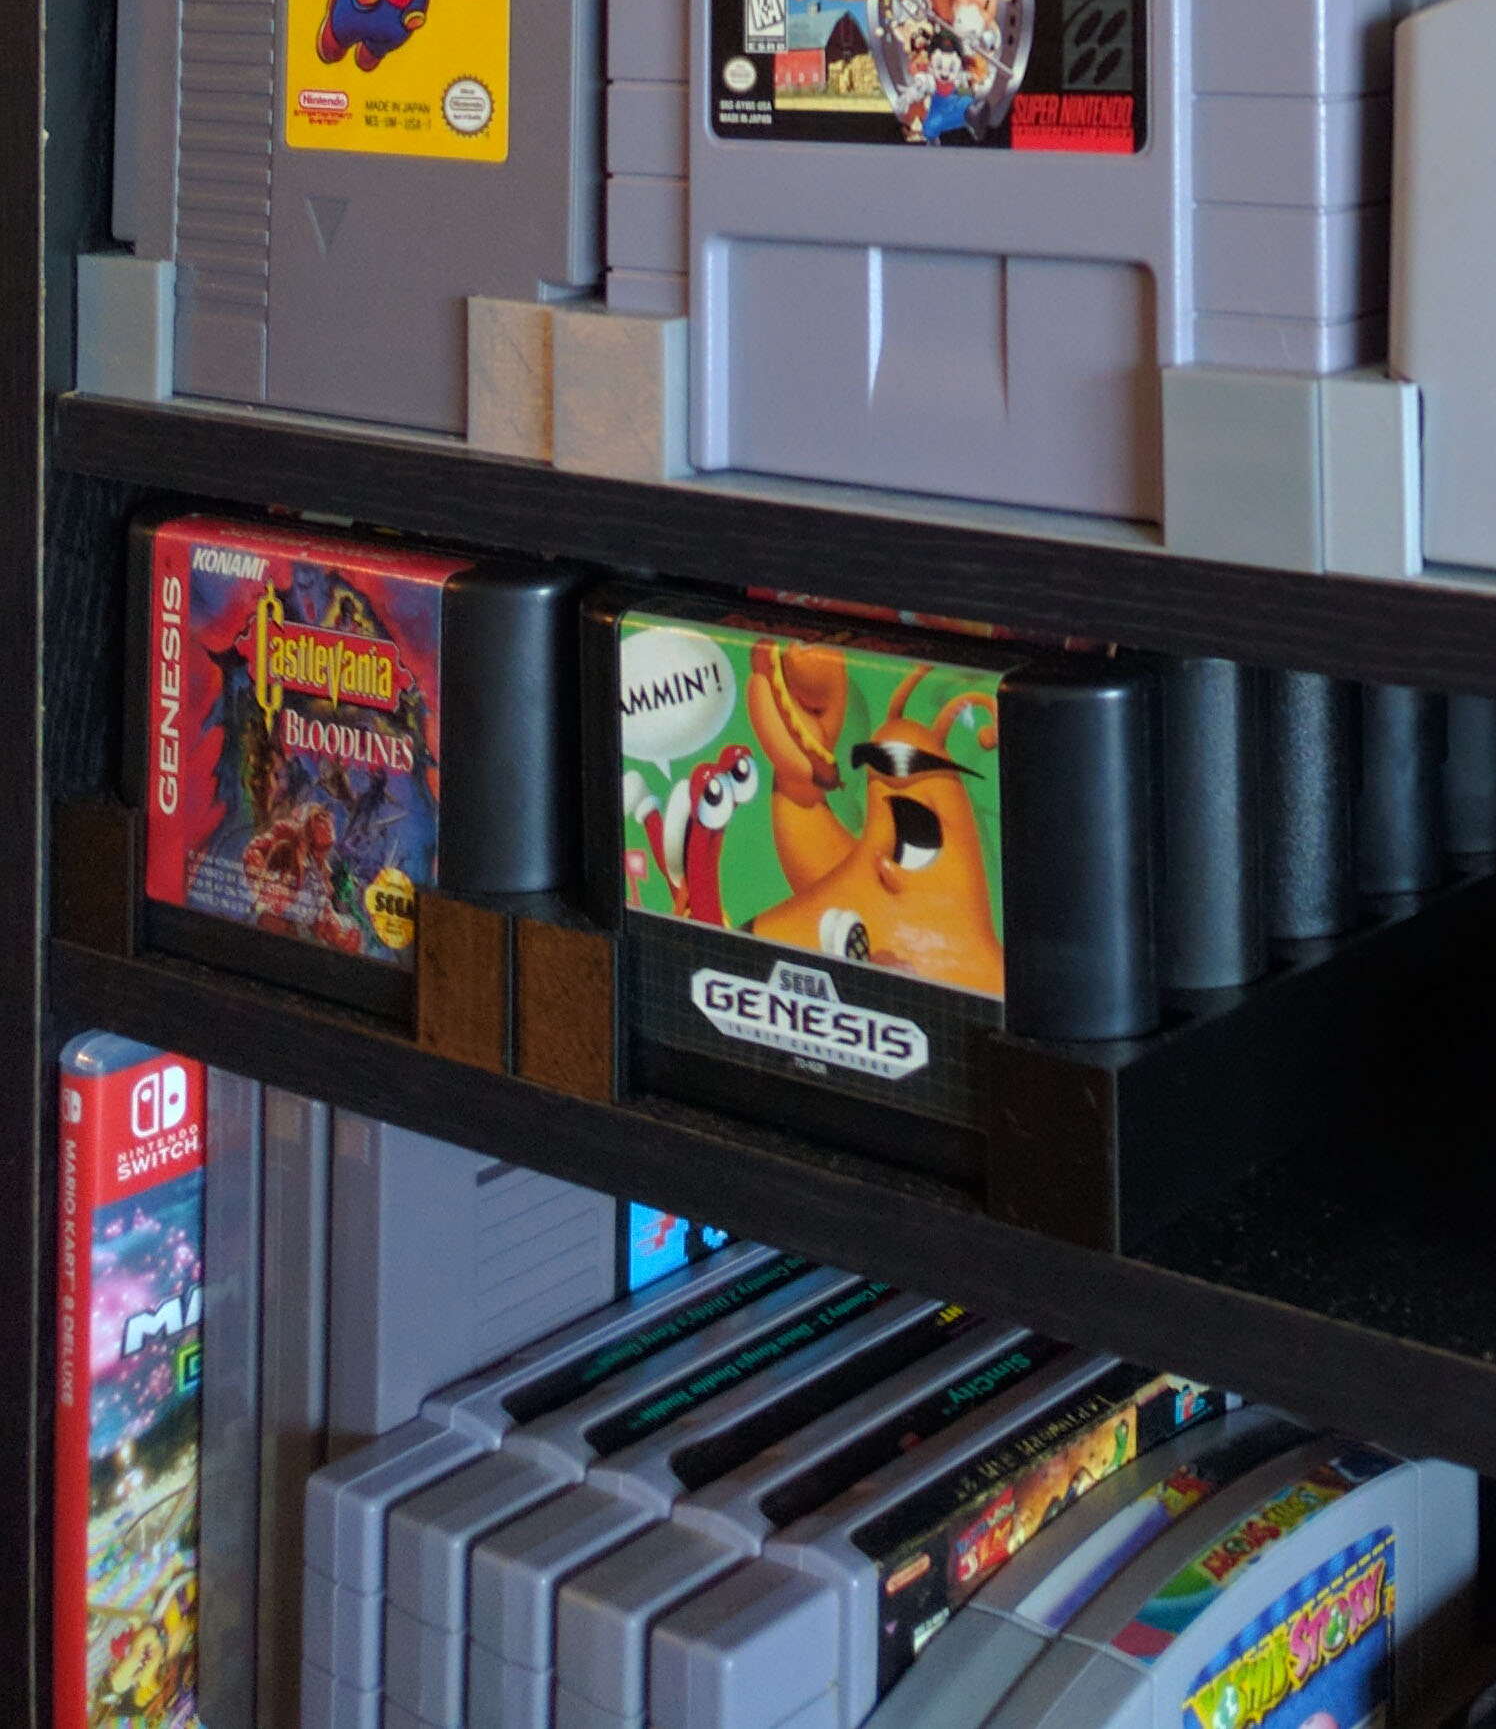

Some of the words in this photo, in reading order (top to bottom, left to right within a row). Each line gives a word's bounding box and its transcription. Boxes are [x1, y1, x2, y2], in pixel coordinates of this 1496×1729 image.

[303, 93, 346, 108] Nintendo
[365, 100, 390, 113] MADE
[402, 102, 432, 115] JAPAN
[1013, 93, 1060, 127] SUPER
[1061, 94, 1134, 128] NINTENDO
[192, 547, 268, 582] KONAMI
[158, 576, 183, 816] GENESIS
[285, 709, 414, 771] BLOODLINES
[779, 969, 830, 1001] SEGA
[705, 979, 912, 1059] GENESIS
[117, 1124, 200, 1163] NINTENDO
[117, 1137, 200, 1183] SWITCH
[63, 1139, 77, 1215] MARIO
[63, 1219, 77, 1279] KART
[62, 1295, 76, 1311] 8
[61, 1315, 76, 1408] DELUXE
[948, 1352, 1032, 1405] SimCity
[1288, 1558, 1387, 1680] STORY
